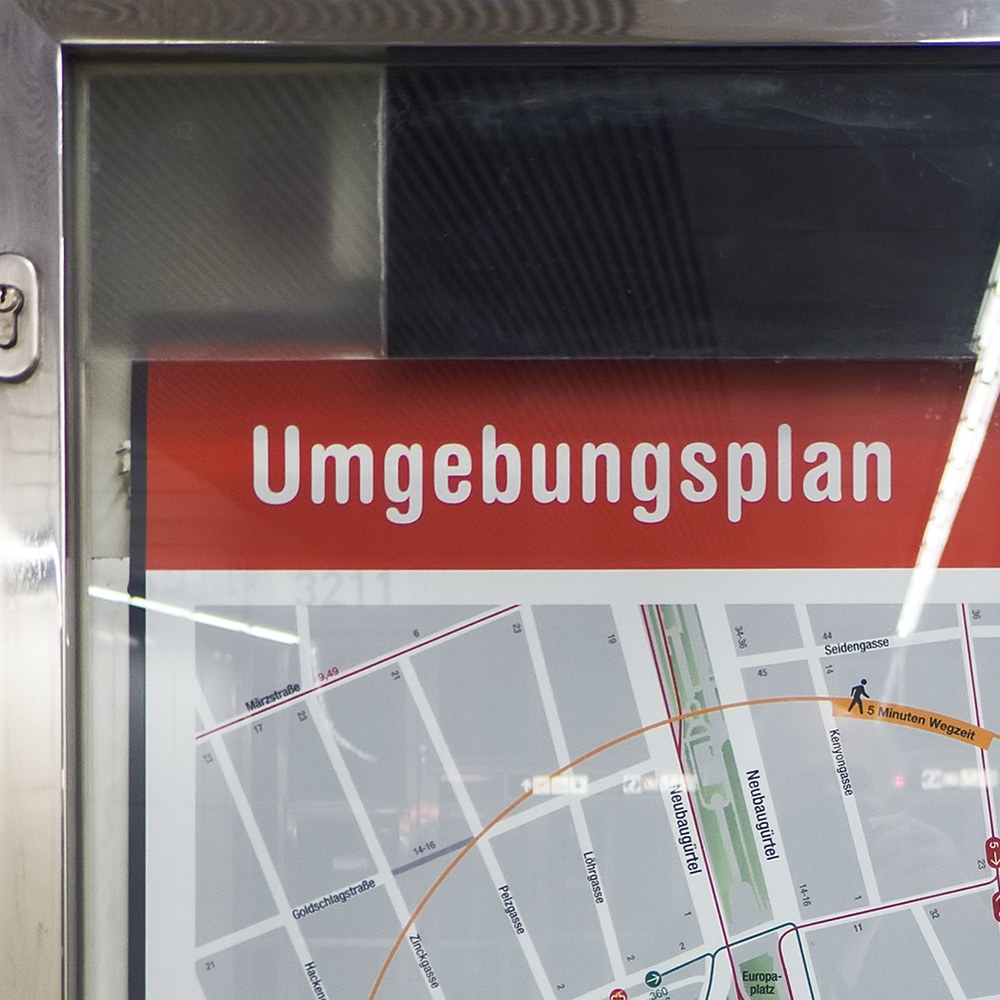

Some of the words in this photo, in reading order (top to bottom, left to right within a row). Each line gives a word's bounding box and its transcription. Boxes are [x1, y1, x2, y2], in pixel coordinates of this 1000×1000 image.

[251, 422, 892, 524] Umgebungsplan
[824, 637, 890, 656] Seidengasse
[318, 667, 339, 682] 9,49
[758, 668, 768, 678] 45
[245, 682, 301, 713] Märzstraße
[867, 706, 875, 715] 5
[878, 706, 926, 725] Minuten
[929, 718, 976, 741] Wegzeit
[829, 729, 853, 796] Kenyongasse
[669, 784, 702, 875] Neubaugürtel
[746, 769, 779, 861] Neubaugürtel
[413, 841, 436, 856] 14-16
[583, 851, 604, 904] Löhrgasse
[291, 878, 376, 921] Goldschlagstraße
[498, 884, 525, 935] Pelzgasse
[409, 934, 440, 989] Zinckgasse
[742, 971, 782, 984] Europa-
[650, 988, 668, 1000] 360
[750, 983, 775, 996] platz
